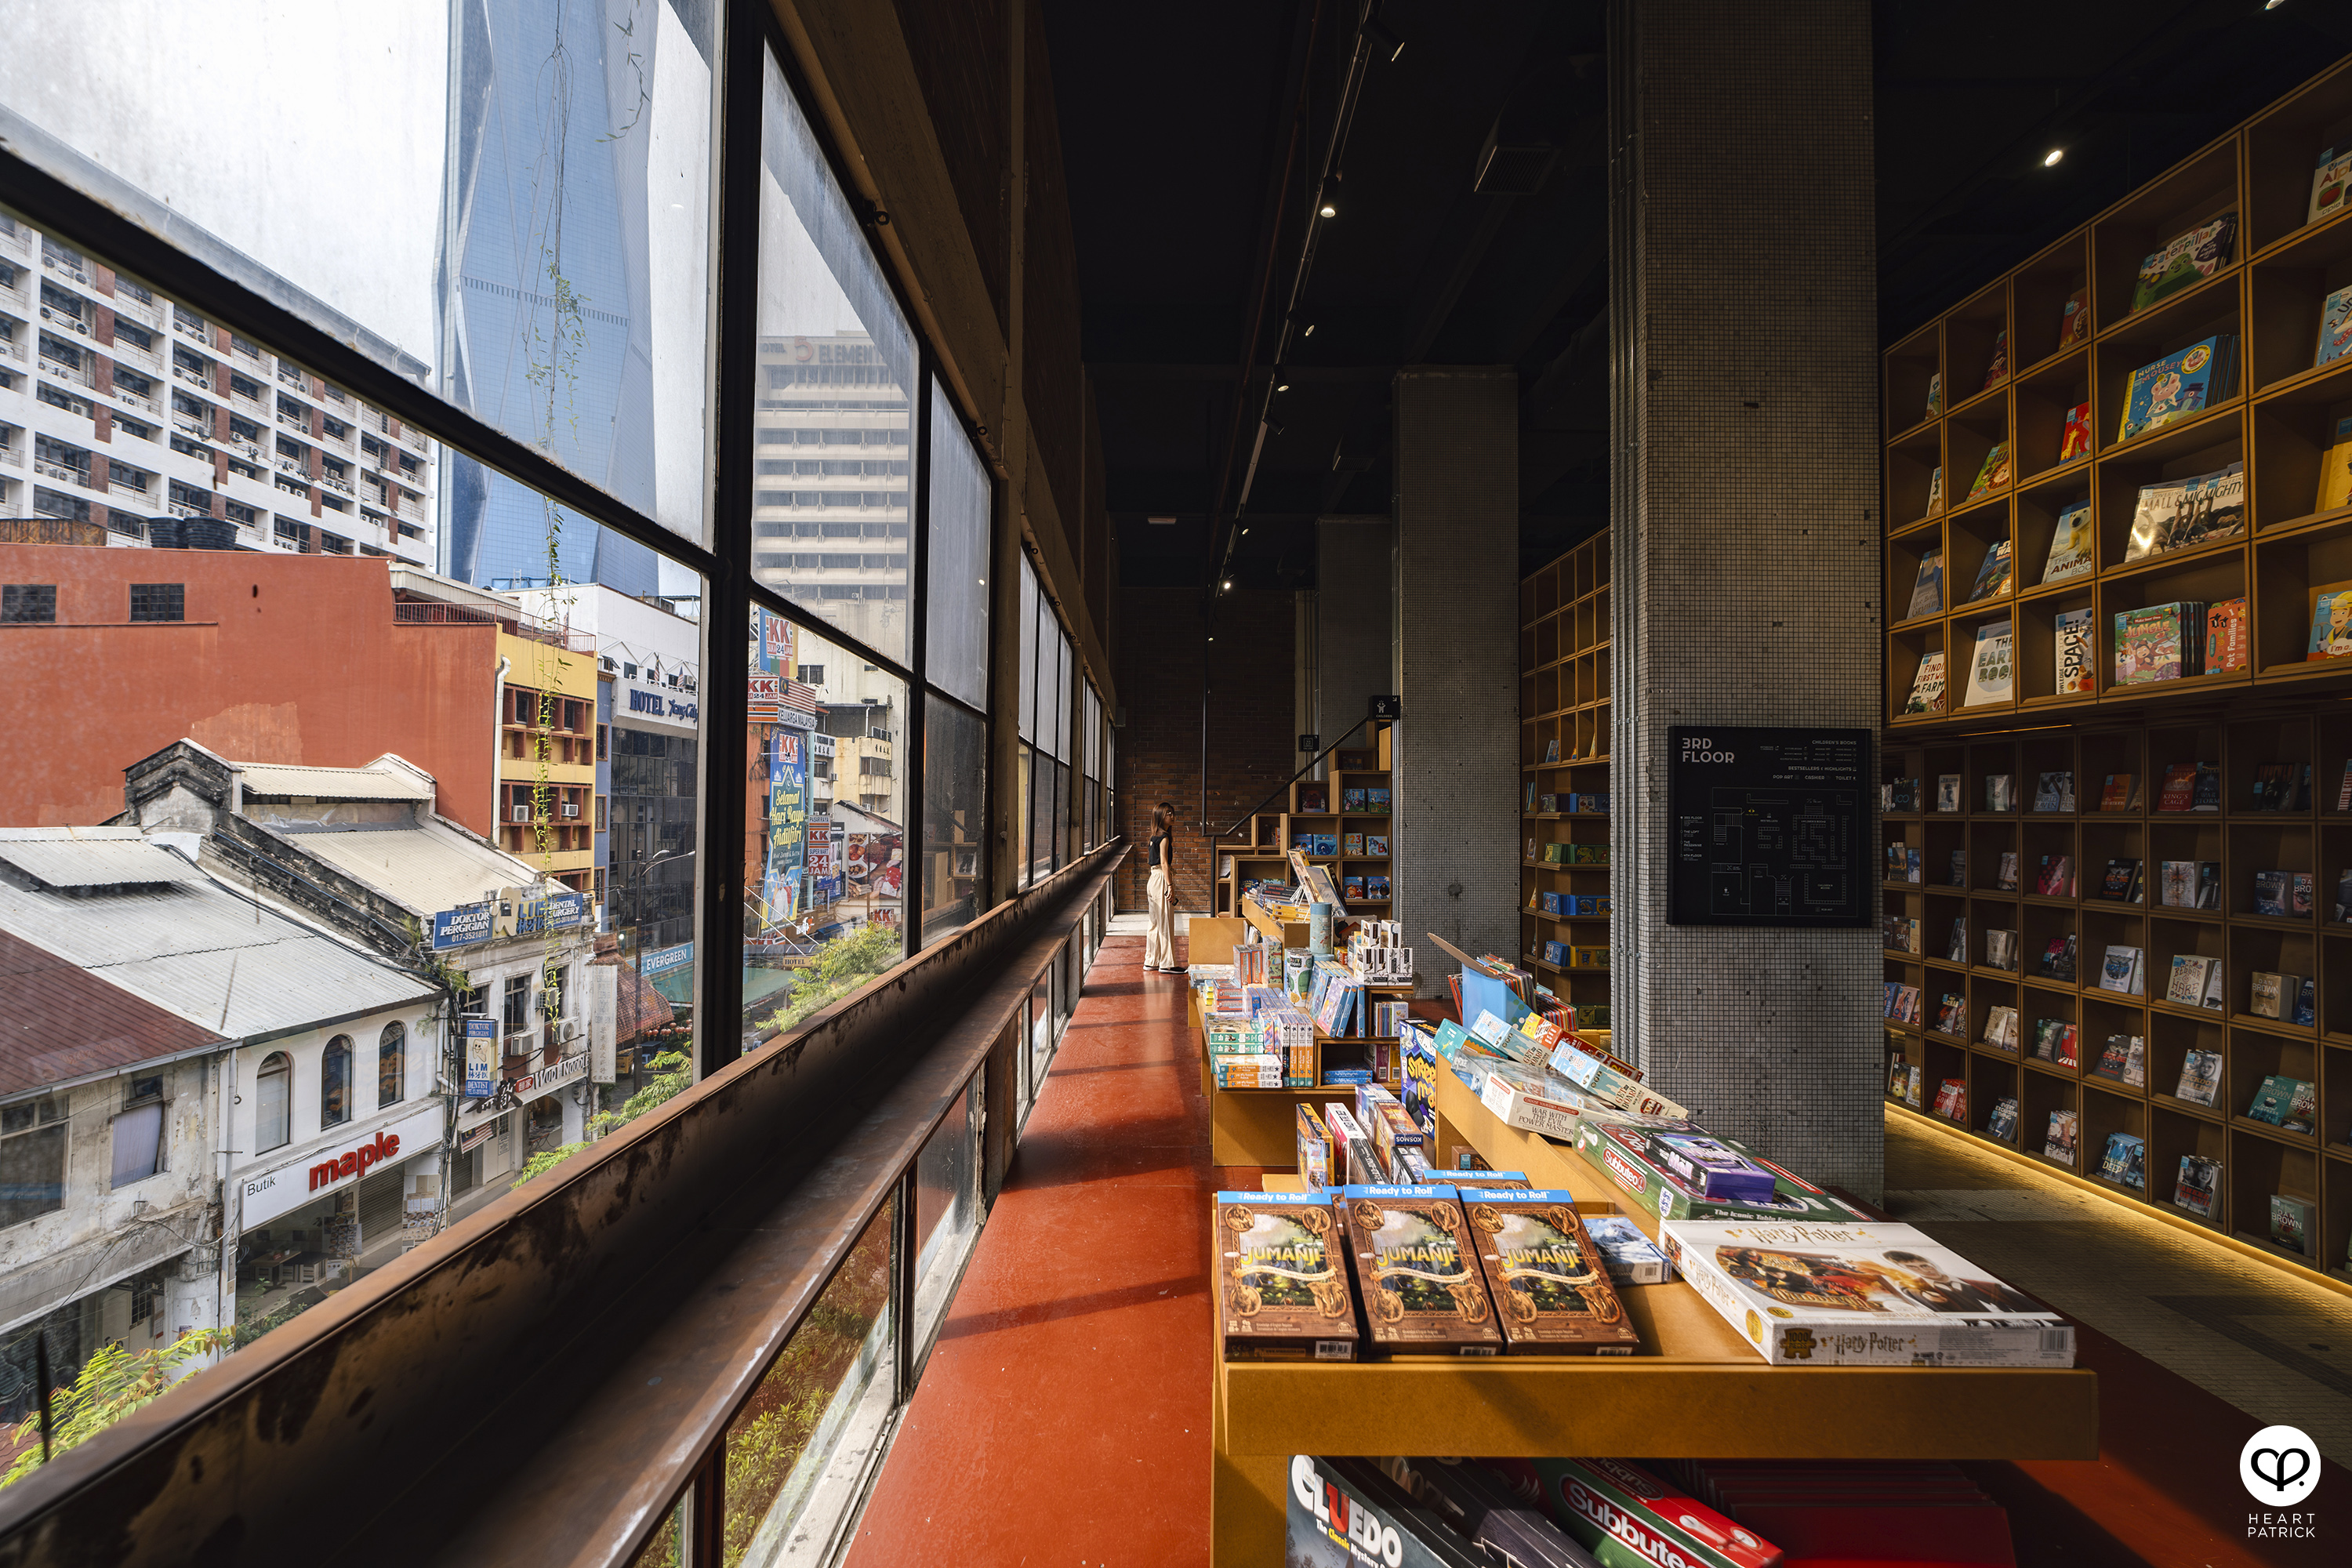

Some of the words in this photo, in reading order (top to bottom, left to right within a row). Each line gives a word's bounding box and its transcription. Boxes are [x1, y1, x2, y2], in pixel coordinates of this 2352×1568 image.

[2139, 360, 2165, 378] NURSE
[2142, 360, 2182, 383] MOUSEY
[770, 618, 790, 644] KK
[2125, 621, 2170, 638] JUNGLE
[2227, 618, 2237, 651] Families
[776, 644, 784, 654] 24
[2064, 619, 2079, 678] SPACE!
[1917, 673, 1934, 683] FIRST
[1978, 665, 2012, 683] BOO
[748, 681, 773, 693] KK
[630, 688, 665, 717] HOTEL
[781, 735, 797, 753] KK
[1682, 739, 1712, 750] 3RD
[1682, 751, 1734, 764] FLOOR
[776, 789, 800, 806] Selamat
[771, 807, 786, 826] Hari
[787, 806, 804, 828] Raya
[774, 826, 801, 849] Aidilfitri
[809, 831, 829, 840] KK
[1345, 835, 1361, 844] 123
[809, 855, 829, 867] 24
[2256, 880, 2284, 890] BROWN
[440, 920, 489, 936] PERGIGIAN
[549, 906, 580, 919] SURGERY
[451, 912, 489, 925] DOKTOR
[549, 900, 577, 911] DENTAL
[874, 909, 892, 922] KK
[452, 930, 488, 942] 017-3521811
[647, 949, 687, 971] EVERGREEN
[2174, 963, 2201, 977] BEGGAR
[2172, 978, 2200, 996] HARE
[2252, 983, 2279, 994] BROWN
[467, 1080, 488, 1090] DENTIST
[2260, 1085, 2292, 1099] BROWN
[1615, 1087, 1627, 1104] GET
[1621, 1086, 1637, 1109] BOARD
[1532, 1107, 1548, 1116] WAR
[1549, 1110, 1567, 1121] WITH
[1549, 1116, 1563, 1127] EVIL
[1518, 1115, 1544, 1128] POWER
[1545, 1122, 1574, 1135] MASTER
[309, 1132, 400, 1191] maple
[1604, 1149, 1639, 1185] Subbuteo
[2103, 1162, 2123, 1173] DEEP
[248, 1176, 276, 1196] Butik
[1369, 1185, 1399, 1196] Ready
[1243, 1193, 1275, 1202] Ready
[1484, 1190, 1513, 1200] Ready
[1730, 1211, 1754, 1220] Iconic
[2271, 1212, 2302, 1229] BROWN
[2277, 1209, 2294, 1219] DAN
[1747, 1226, 1799, 1245] Harry
[1791, 1225, 1857, 1247] Potter
[1240, 1247, 1320, 1266] JUMANJI
[1376, 1247, 1455, 1267] JUMANJI
[1502, 1248, 1581, 1269] JUMANJI
[1696, 1264, 1711, 1290] Harry
[1711, 1274, 1730, 1306] Potter
[1772, 1308, 1789, 1316] 10+
[1788, 1333, 1808, 1342] 1000
[1835, 1334, 1867, 1355] Harry
[1869, 1332, 1904, 1356] Potter
[1292, 1455, 1402, 1568] CLUEDO
[1316, 1519, 1327, 1534] The
[1328, 1528, 1350, 1551] Classic
[1351, 1541, 1379, 1568] Mystery
